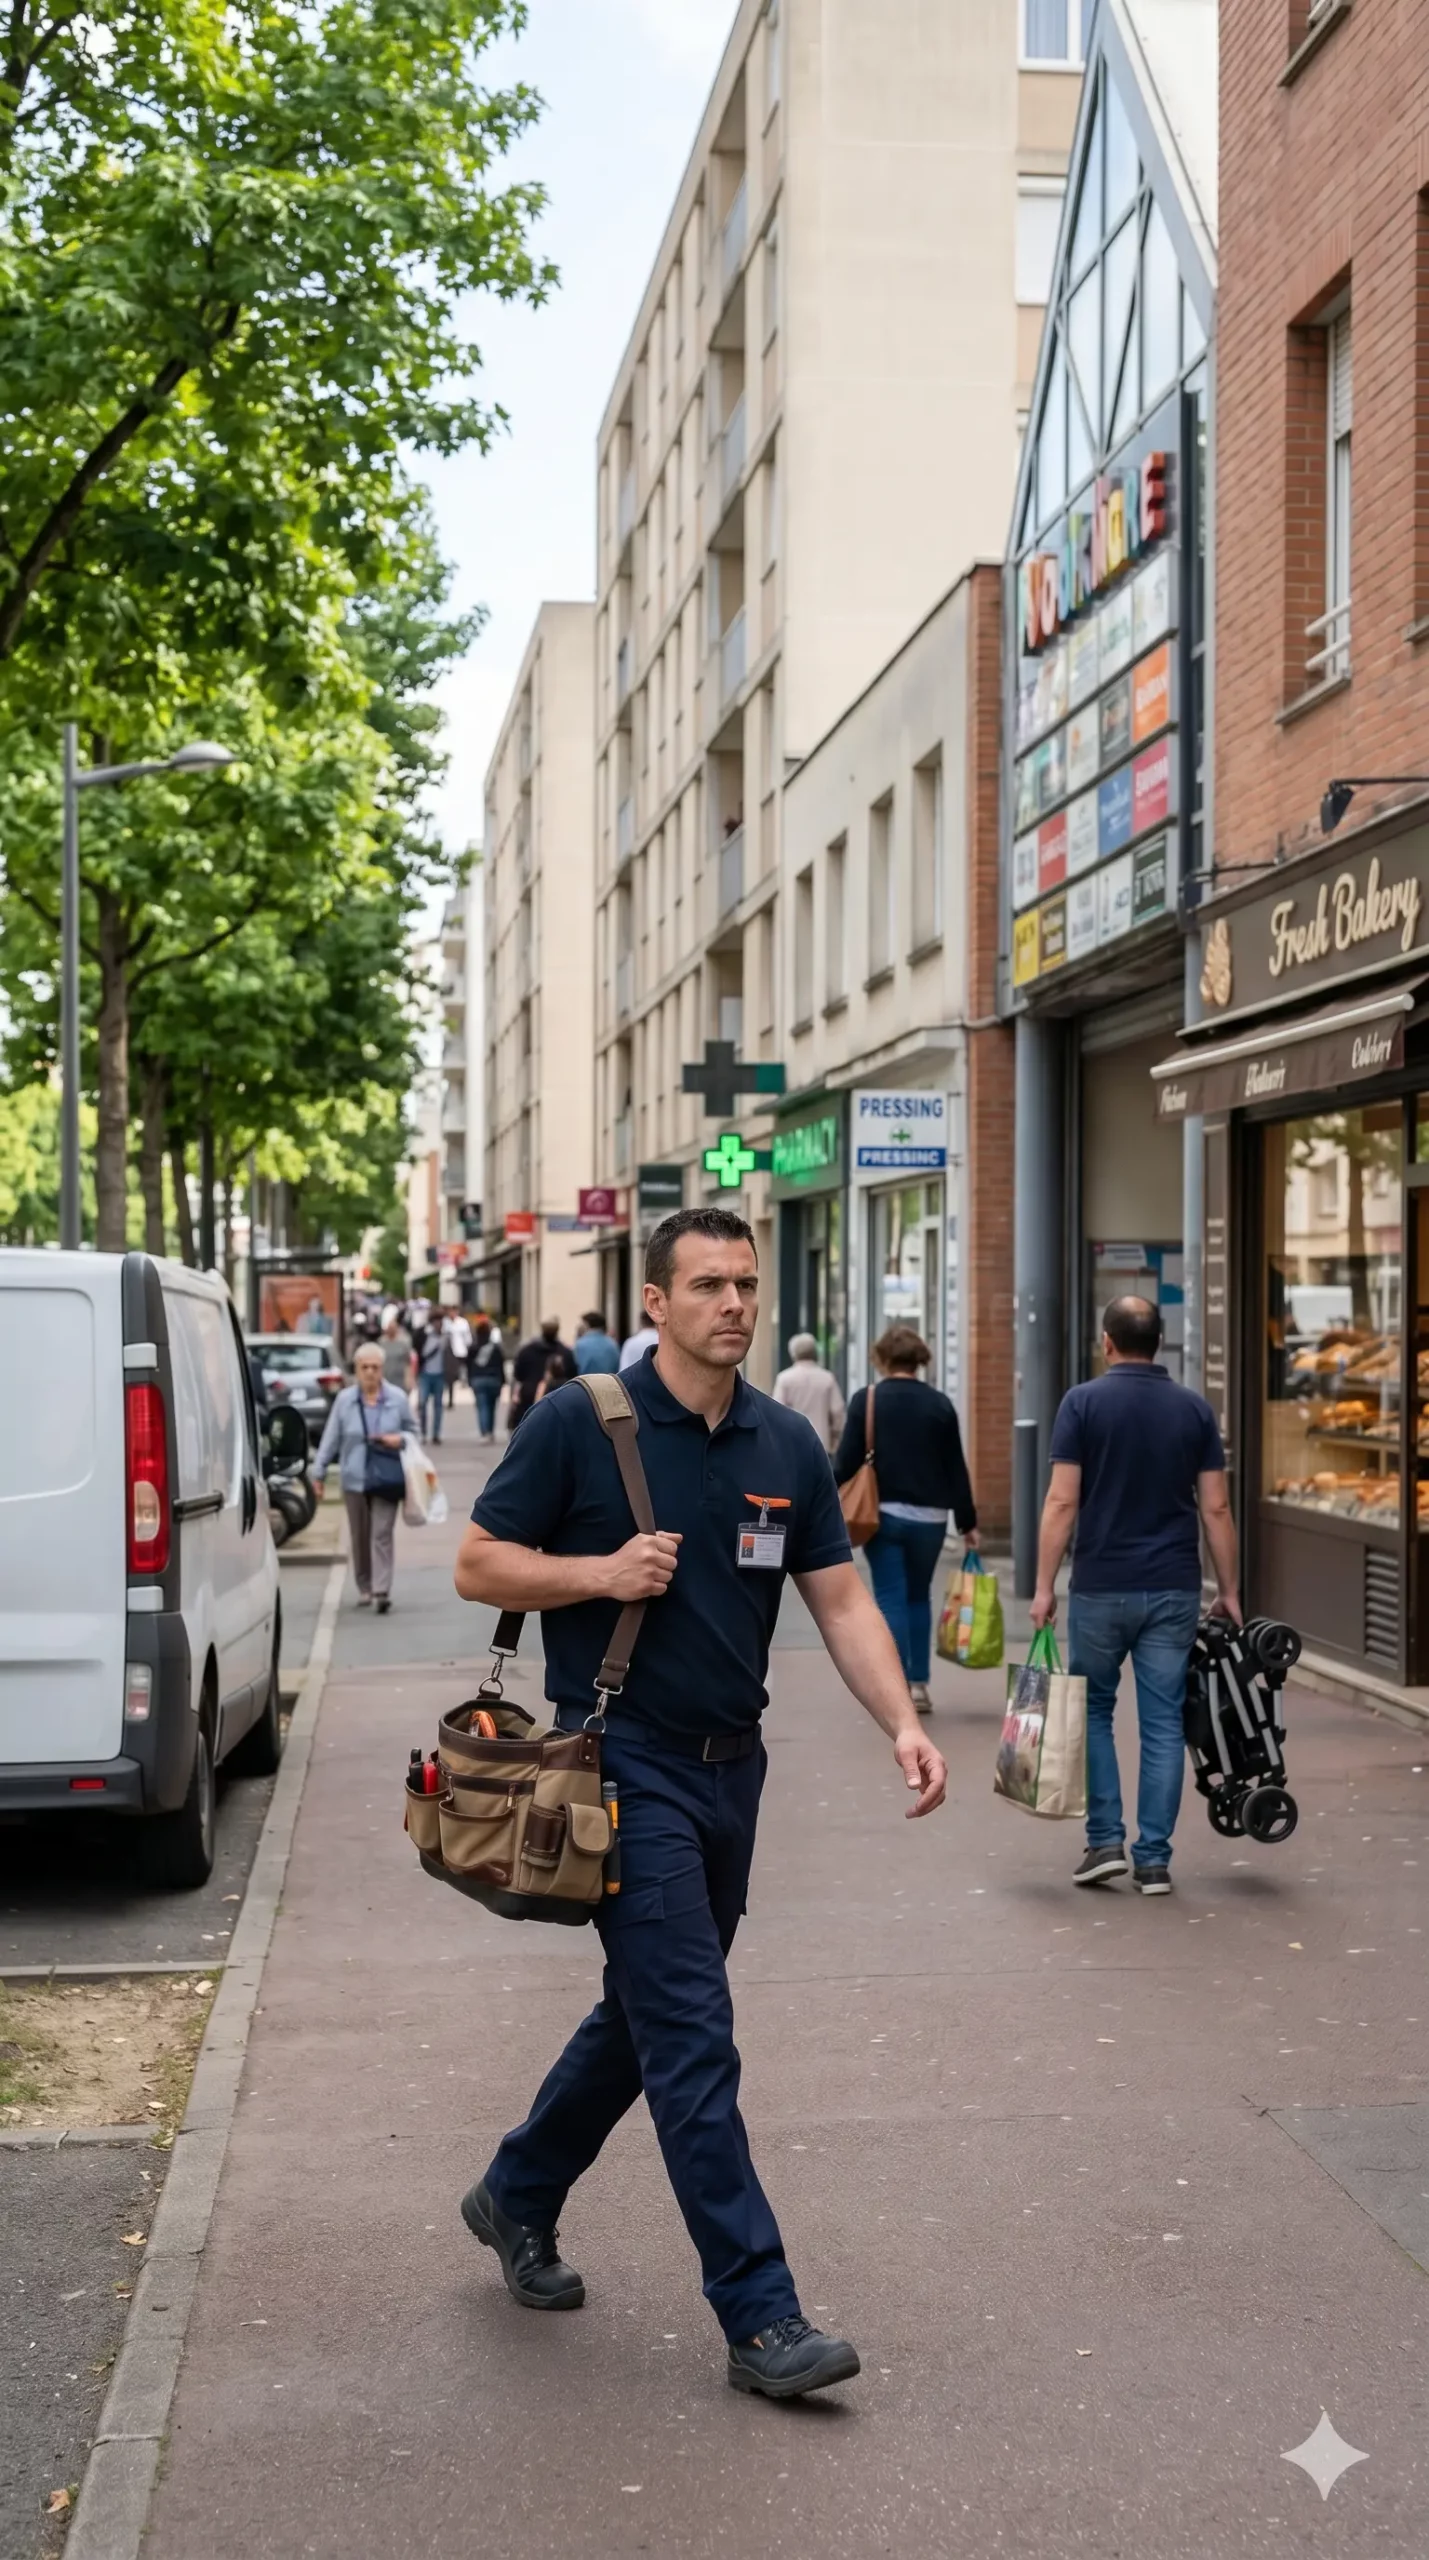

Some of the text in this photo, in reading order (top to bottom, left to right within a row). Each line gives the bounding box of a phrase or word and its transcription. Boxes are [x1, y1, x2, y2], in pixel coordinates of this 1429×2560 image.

[1268, 883, 1330, 978] Fresh
[1331, 856, 1421, 953] Bakery
[860, 1097, 943, 1119] PRESSING
